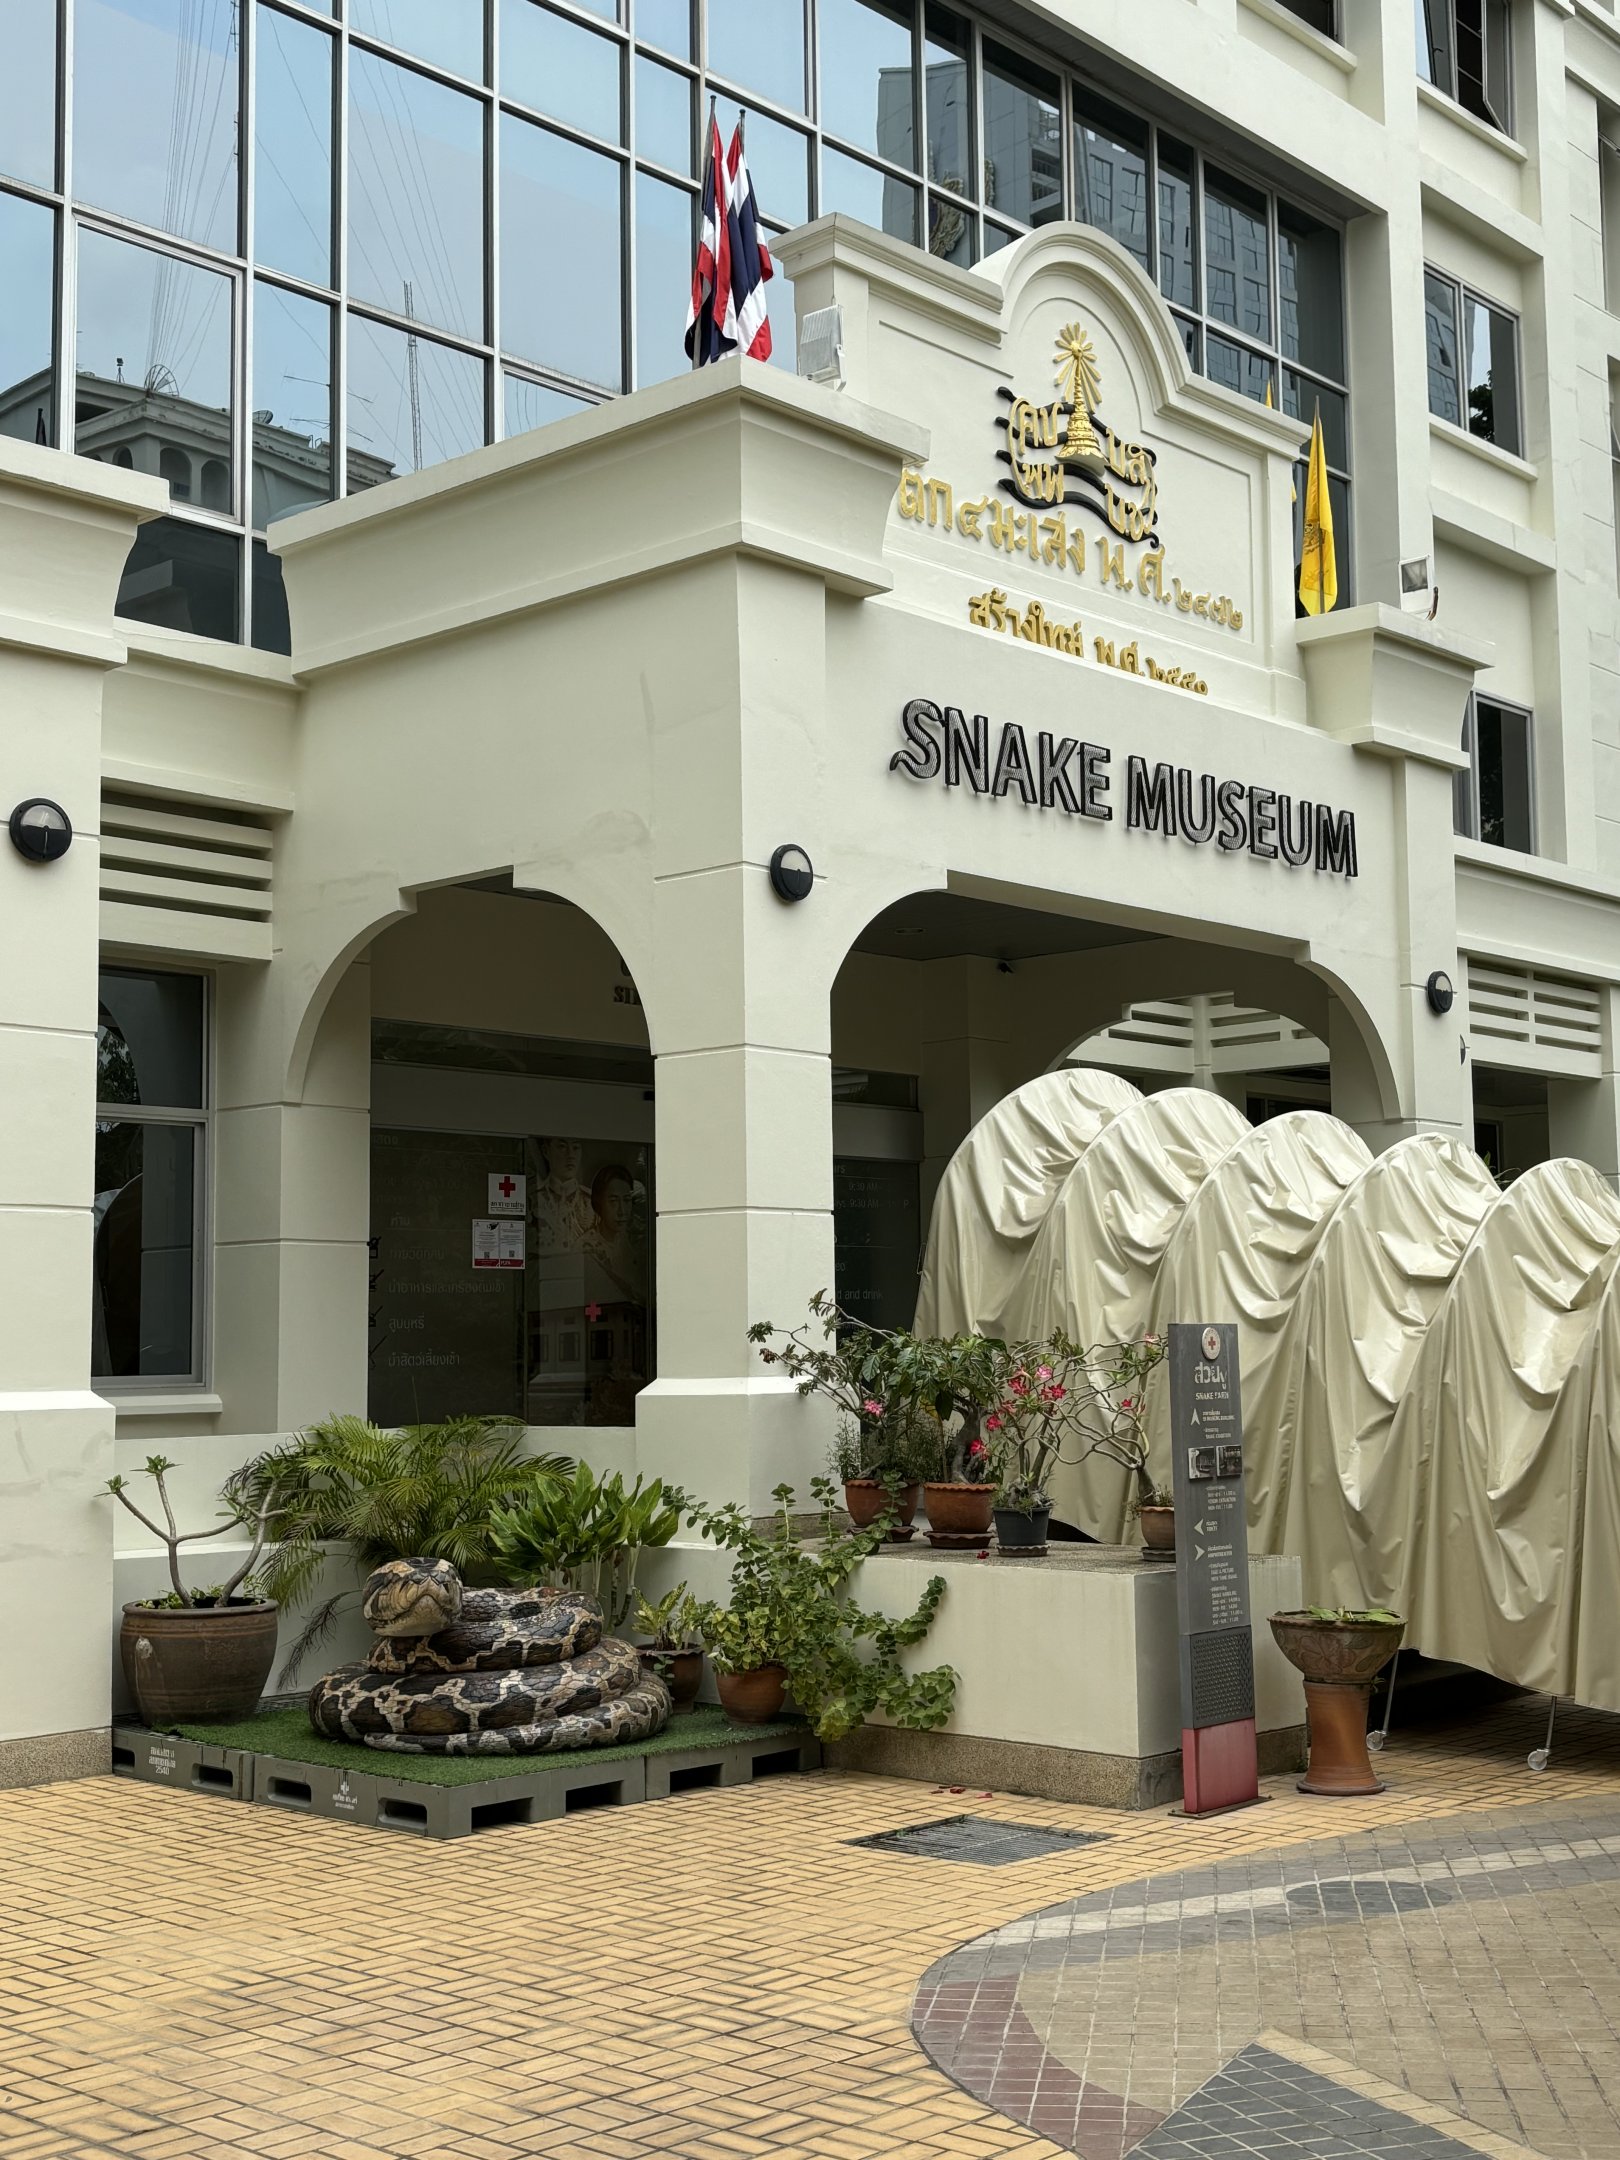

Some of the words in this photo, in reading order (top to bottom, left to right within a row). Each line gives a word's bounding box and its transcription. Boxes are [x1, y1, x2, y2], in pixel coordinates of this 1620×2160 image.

[889, 699, 1113, 822] SNAKE
[1127, 754, 1358, 878] MUSEUM
[845, 1289, 860, 1300] and
[1194, 1361, 1228, 1390] สวนงู
[1195, 1391, 1214, 1401] SNAKE
